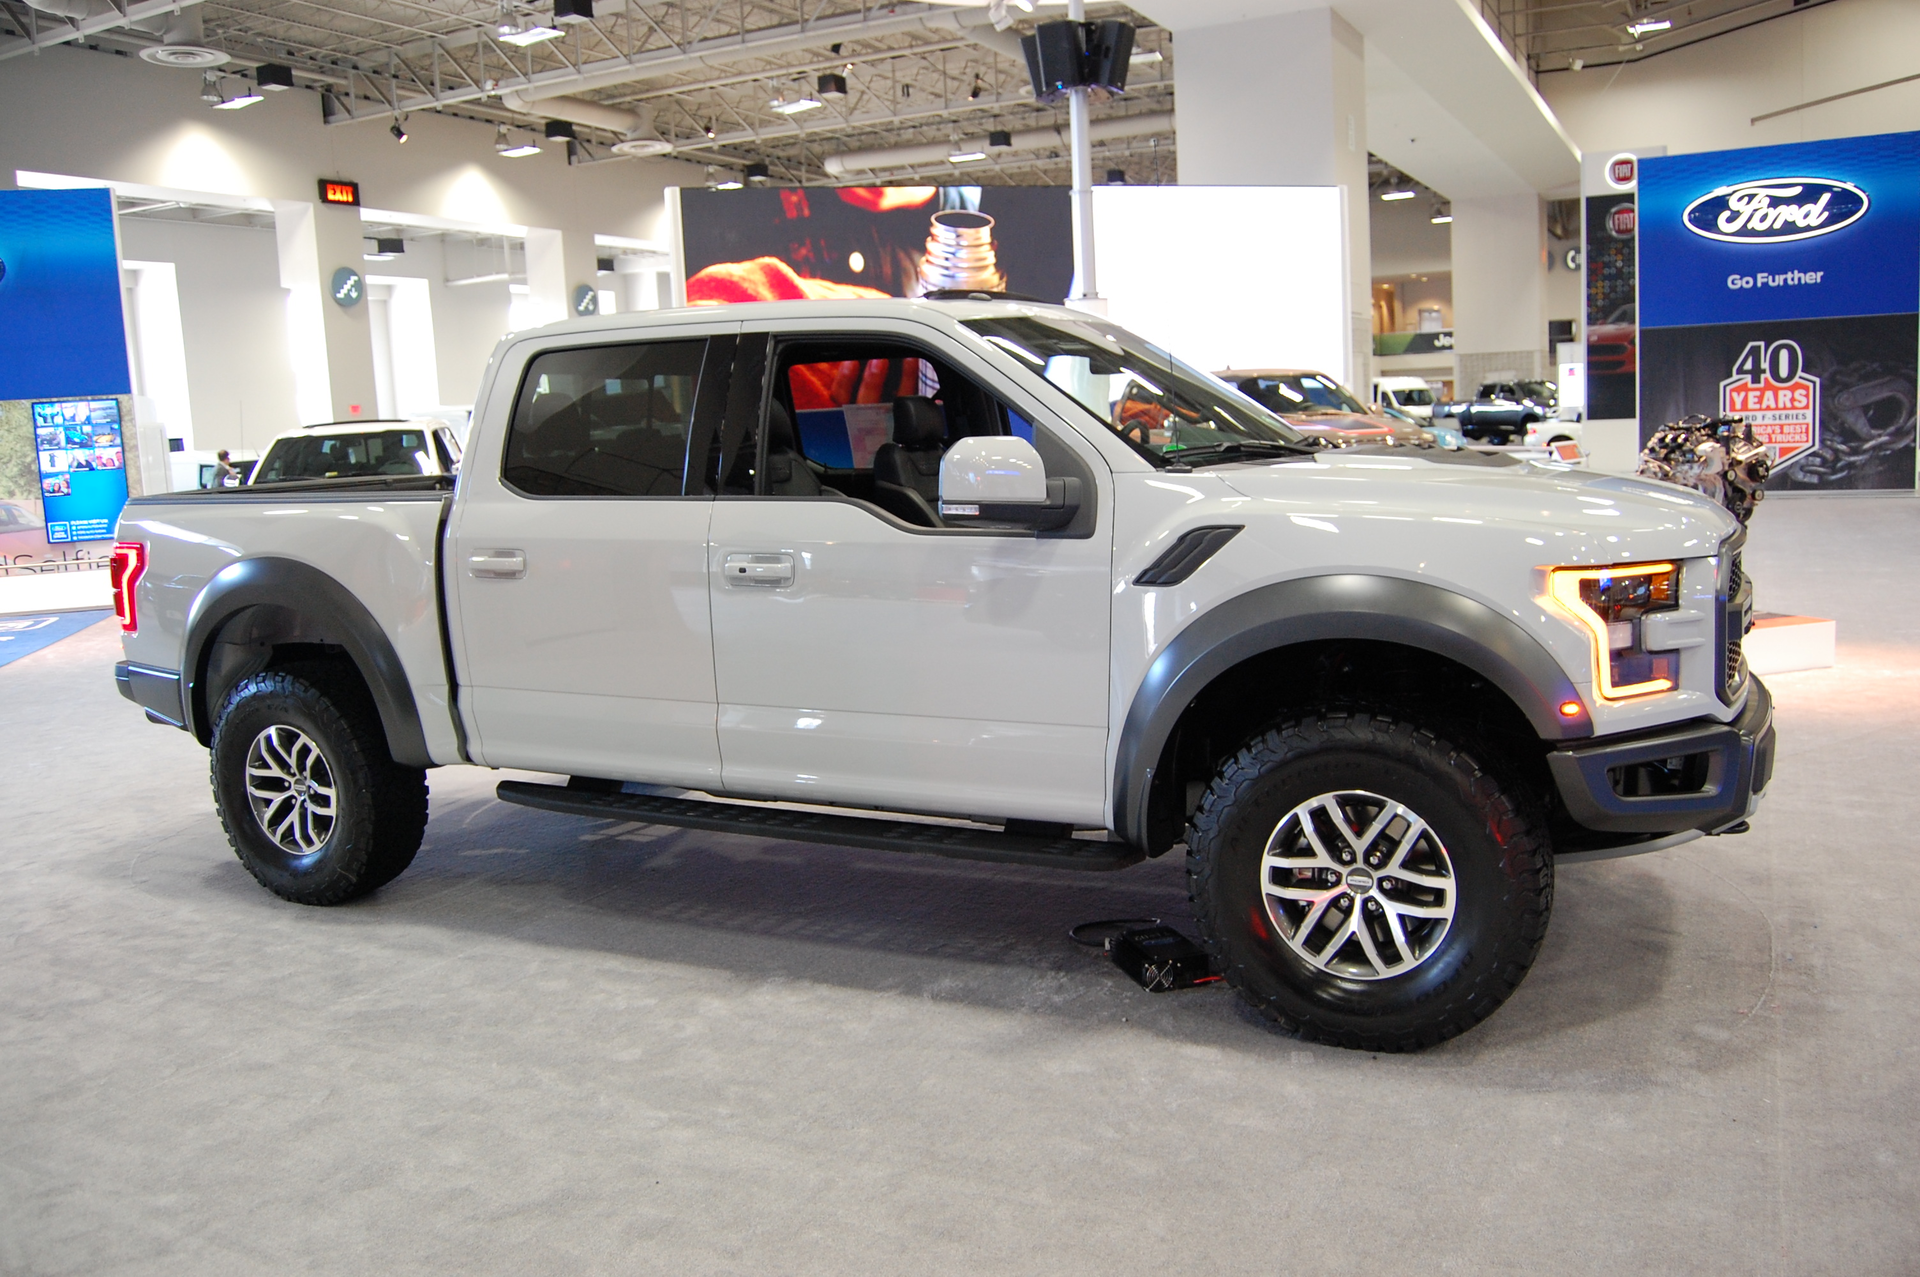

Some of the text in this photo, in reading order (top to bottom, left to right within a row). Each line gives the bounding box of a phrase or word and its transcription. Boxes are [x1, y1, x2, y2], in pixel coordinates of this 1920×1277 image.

[1614, 164, 1632, 180] FIAT
[327, 184, 354, 202] EXIT
[1717, 186, 1832, 233] Ford
[1614, 212, 1635, 231] FIAT
[1727, 270, 1824, 289] Go Further
[1434, 333, 1453, 347] Je
[1734, 342, 1801, 386] 40
[1731, 389, 1808, 410] YEARS
[1762, 412, 1807, 421] F-SERIES
[1771, 433, 1808, 442] TRUCKS
[1784, 424, 1808, 433] BEST
